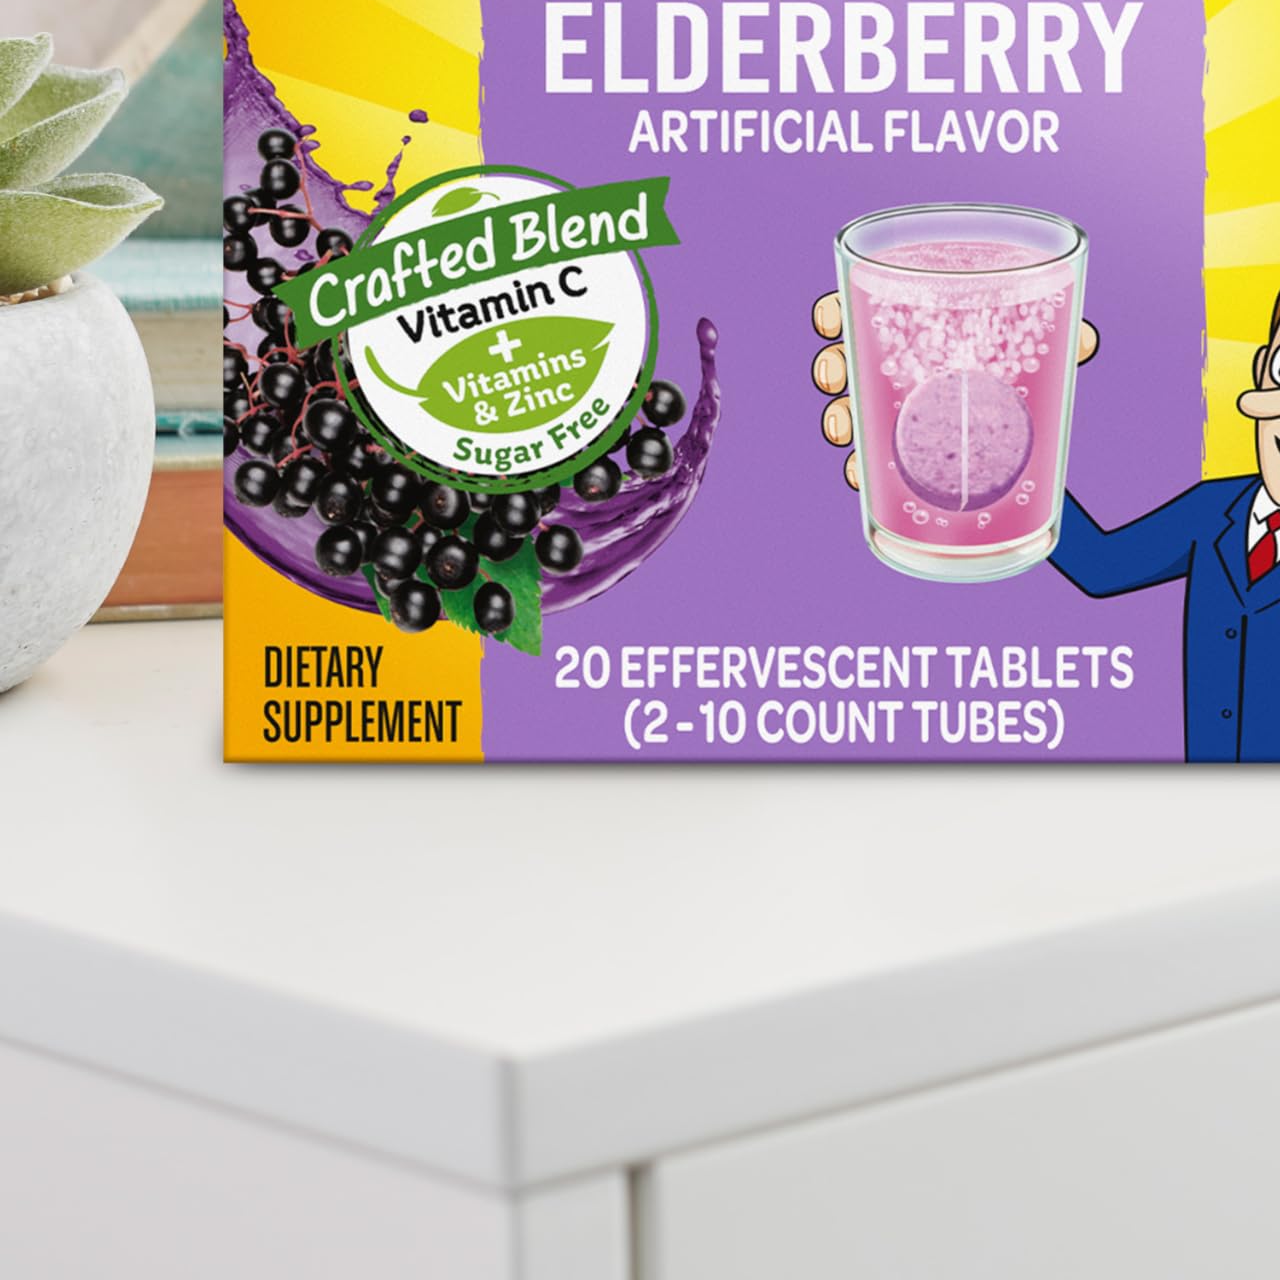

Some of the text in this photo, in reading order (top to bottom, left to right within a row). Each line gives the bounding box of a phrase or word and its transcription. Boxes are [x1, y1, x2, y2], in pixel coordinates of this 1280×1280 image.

[544, 0, 1146, 95] ELDERBERRY
[627, 108, 1060, 154] ARTIFICIAL FLAVOR
[308, 191, 649, 328] Crafted Blend
[396, 265, 589, 345] Vitamin C
[487, 329, 523, 364] +
[442, 347, 588, 405] Vitamins
[473, 381, 576, 427] & Zinc
[452, 396, 611, 473] Sugar Free
[263, 645, 384, 689] DIETARY
[554, 645, 1135, 690] 20 EFFERVESCENT TABLETS
[263, 699, 463, 744] SUPPLEMENT
[755, 698, 905, 745] COUNT
[910, 697, 1066, 751] TUBES)
